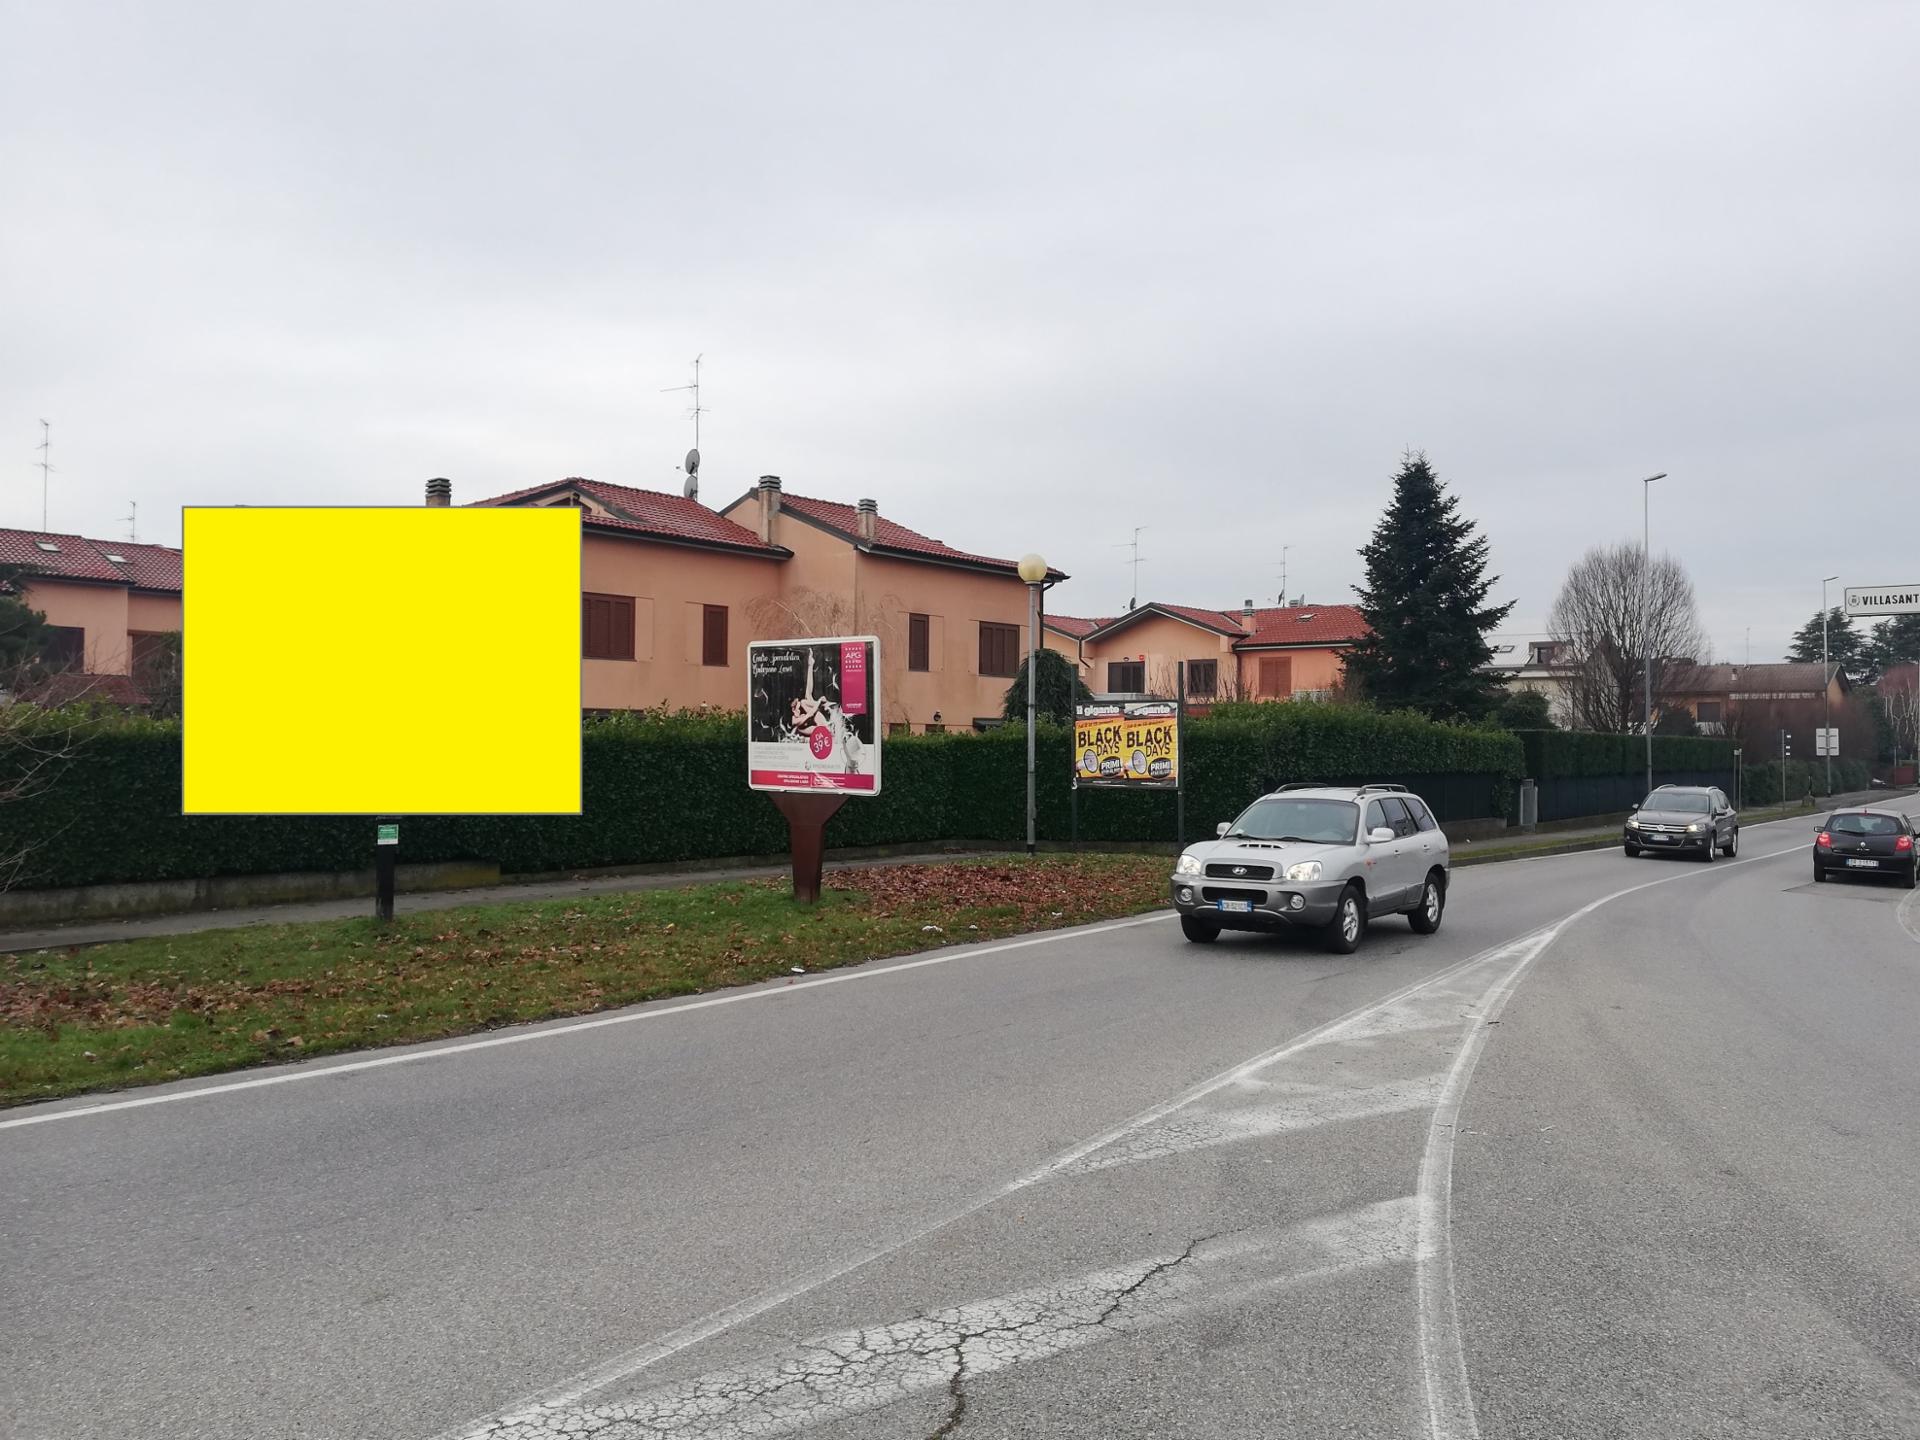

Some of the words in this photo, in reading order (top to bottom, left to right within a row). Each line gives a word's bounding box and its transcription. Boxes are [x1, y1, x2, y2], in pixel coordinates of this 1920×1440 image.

[1084, 705, 1119, 716] gigante
[1078, 725, 1122, 748] BLACK
[1126, 725, 1173, 748] BLACK
[1097, 741, 1120, 757] DAYS
[1145, 742, 1171, 758] DAYS
